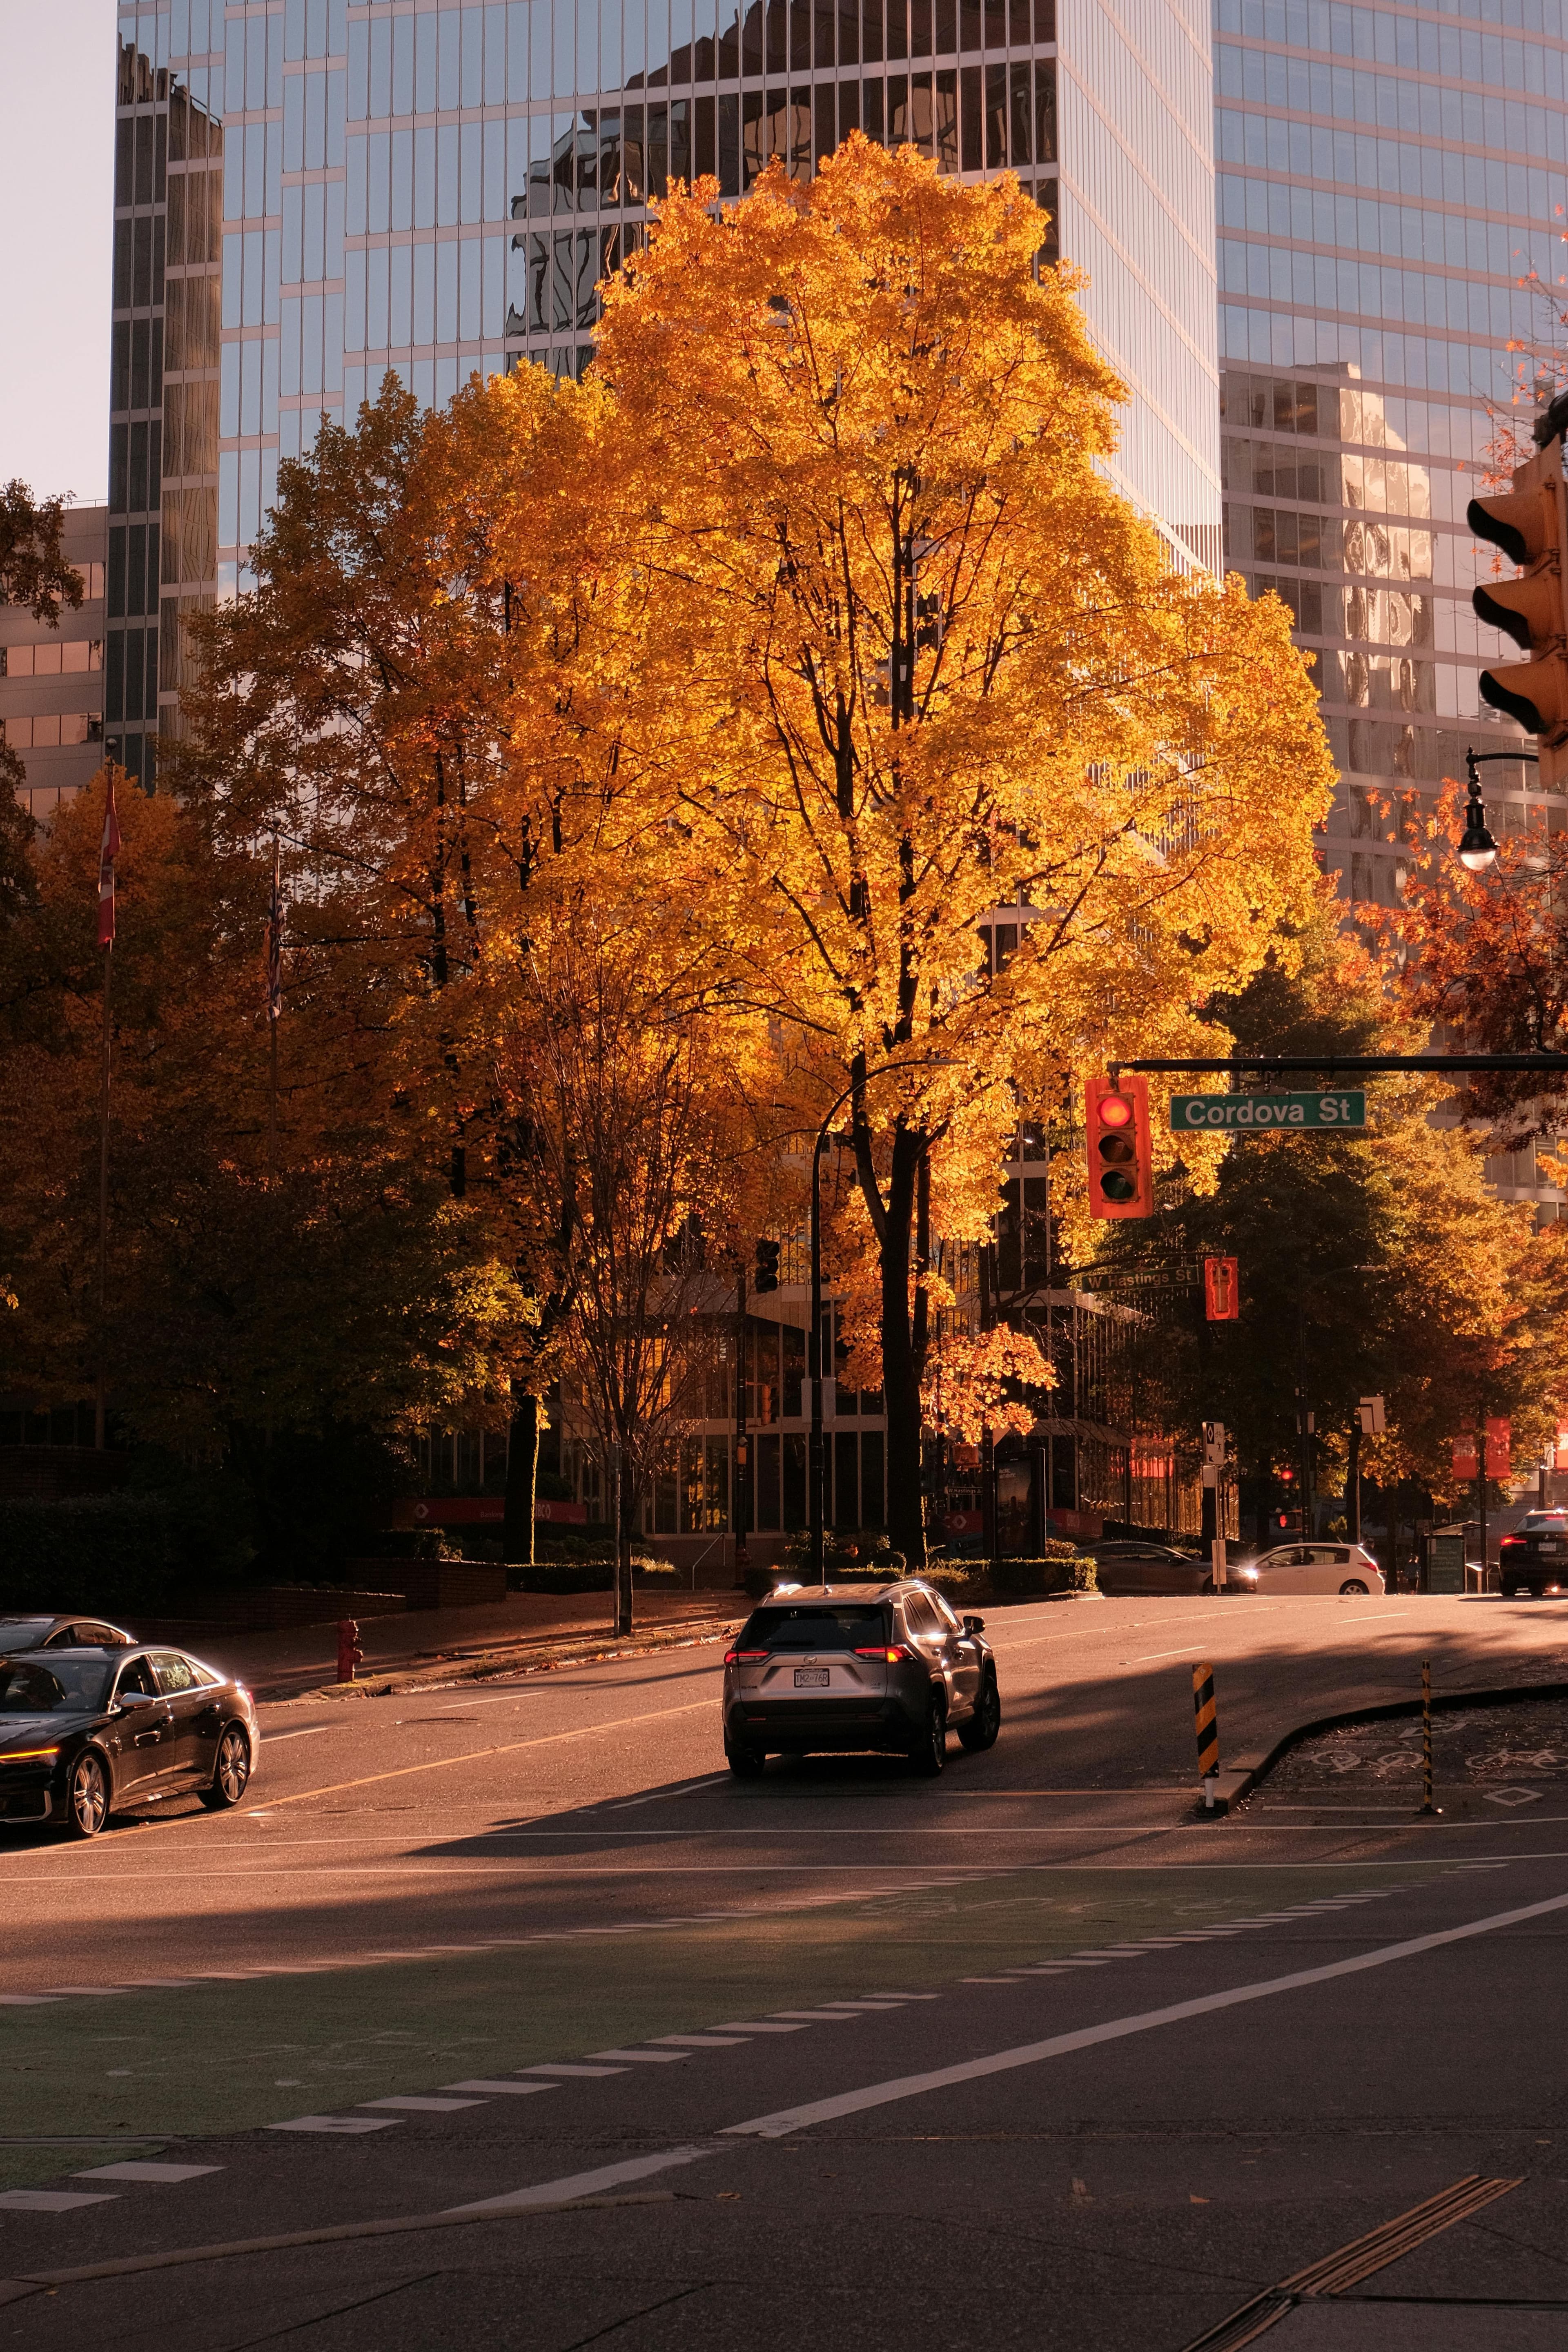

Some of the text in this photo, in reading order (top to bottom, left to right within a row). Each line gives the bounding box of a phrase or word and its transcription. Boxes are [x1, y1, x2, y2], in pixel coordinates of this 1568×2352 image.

[1185, 1097, 1350, 1125] Cordova St
[1088, 1269, 1191, 1289] W Hastings St
